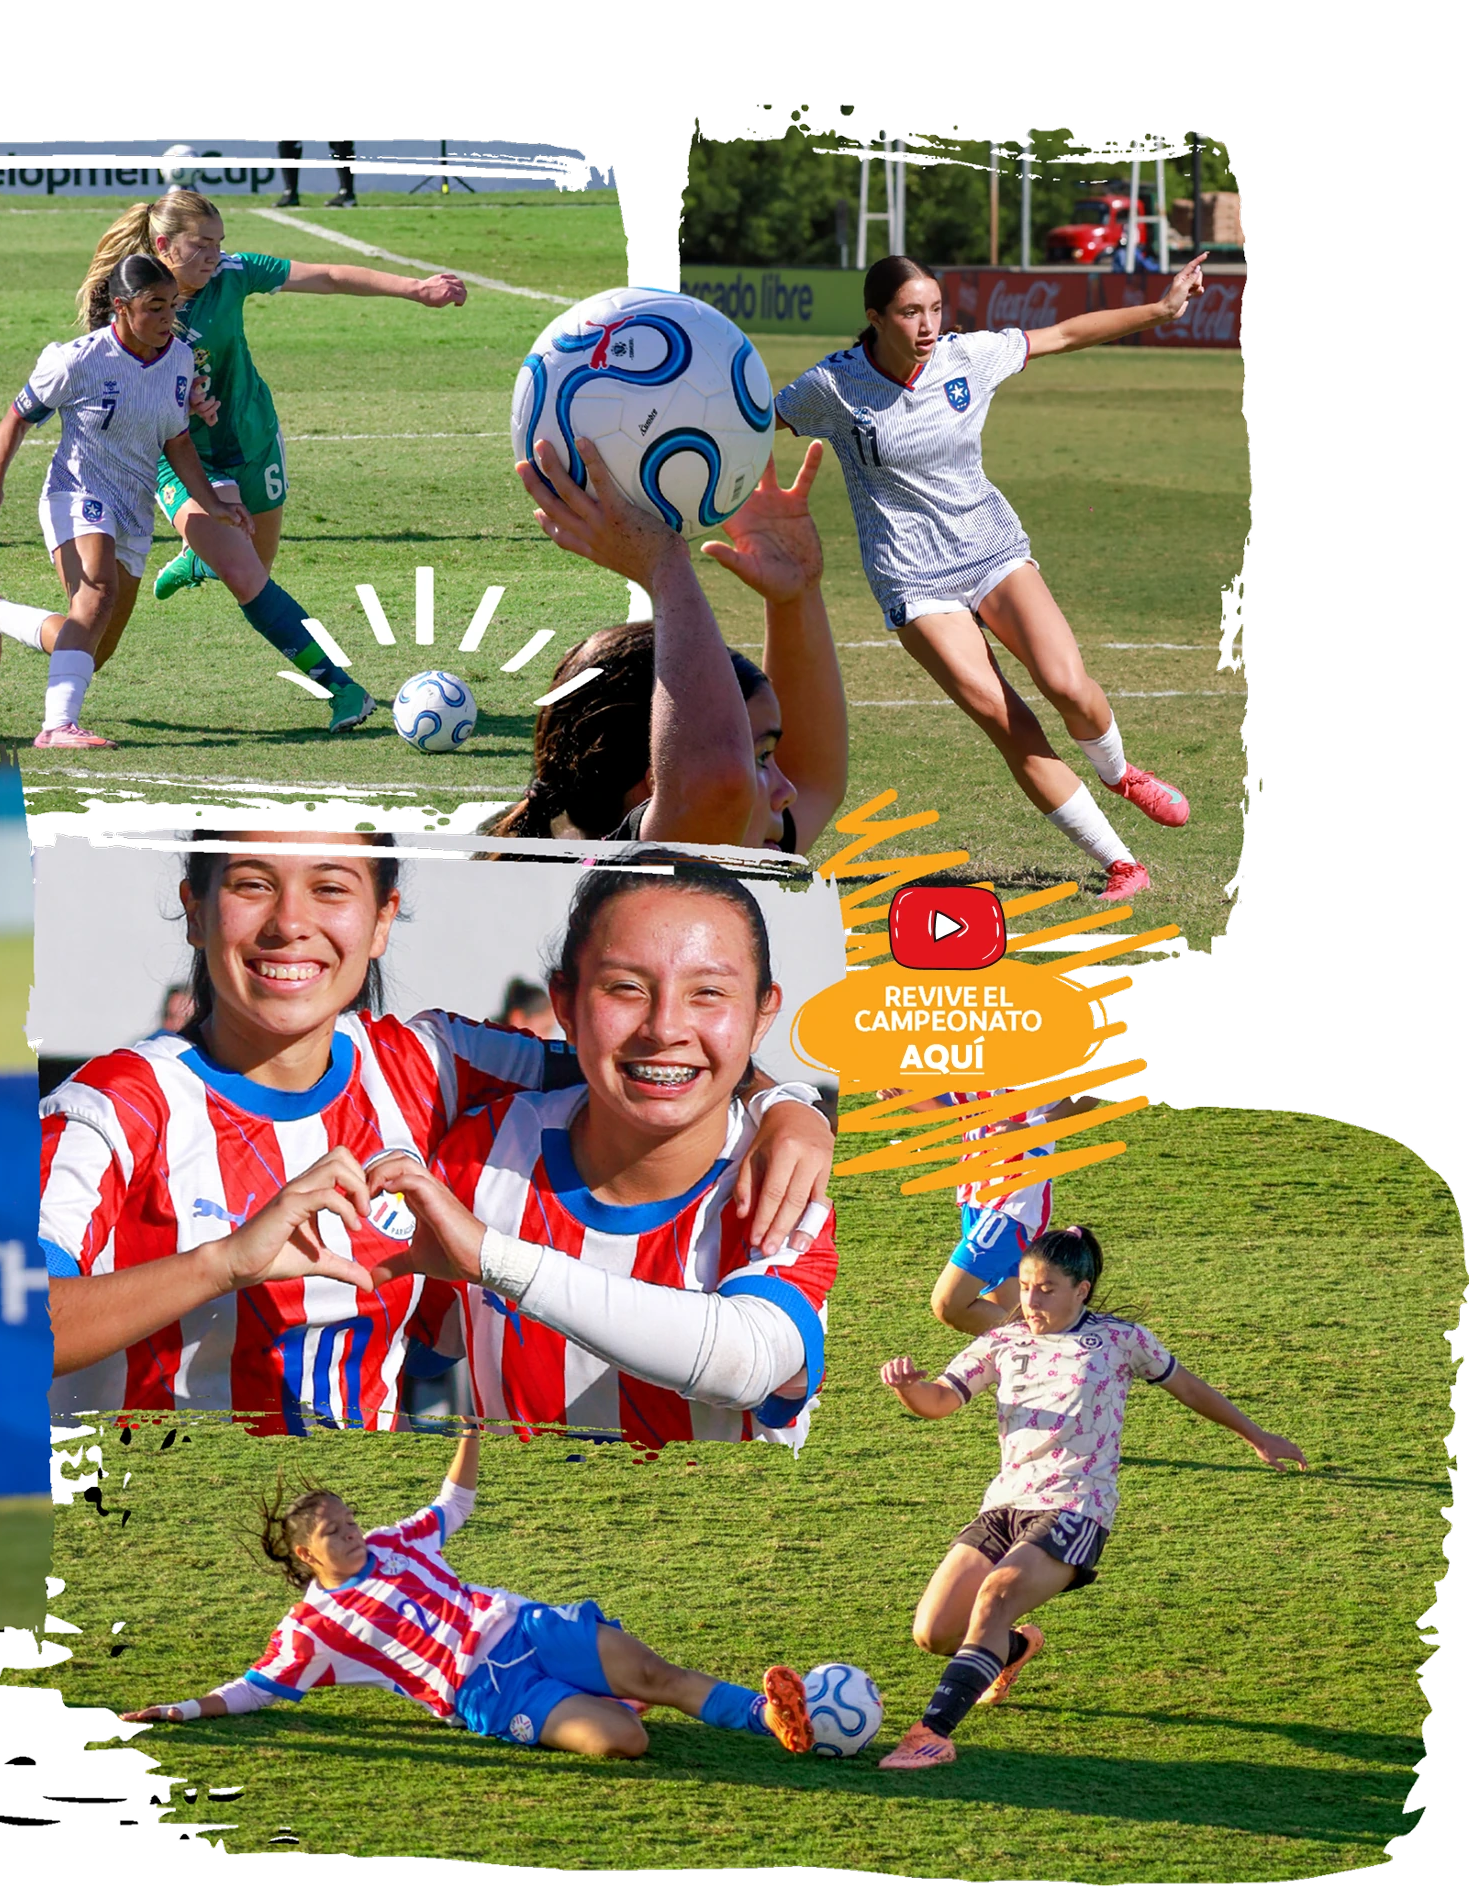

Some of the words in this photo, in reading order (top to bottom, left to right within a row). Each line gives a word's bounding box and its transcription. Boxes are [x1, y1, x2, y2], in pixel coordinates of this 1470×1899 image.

[761, 274, 814, 322] libre
[100, 398, 116, 431] 7
[850, 426, 882, 467] 11
[263, 463, 283, 500] 6
